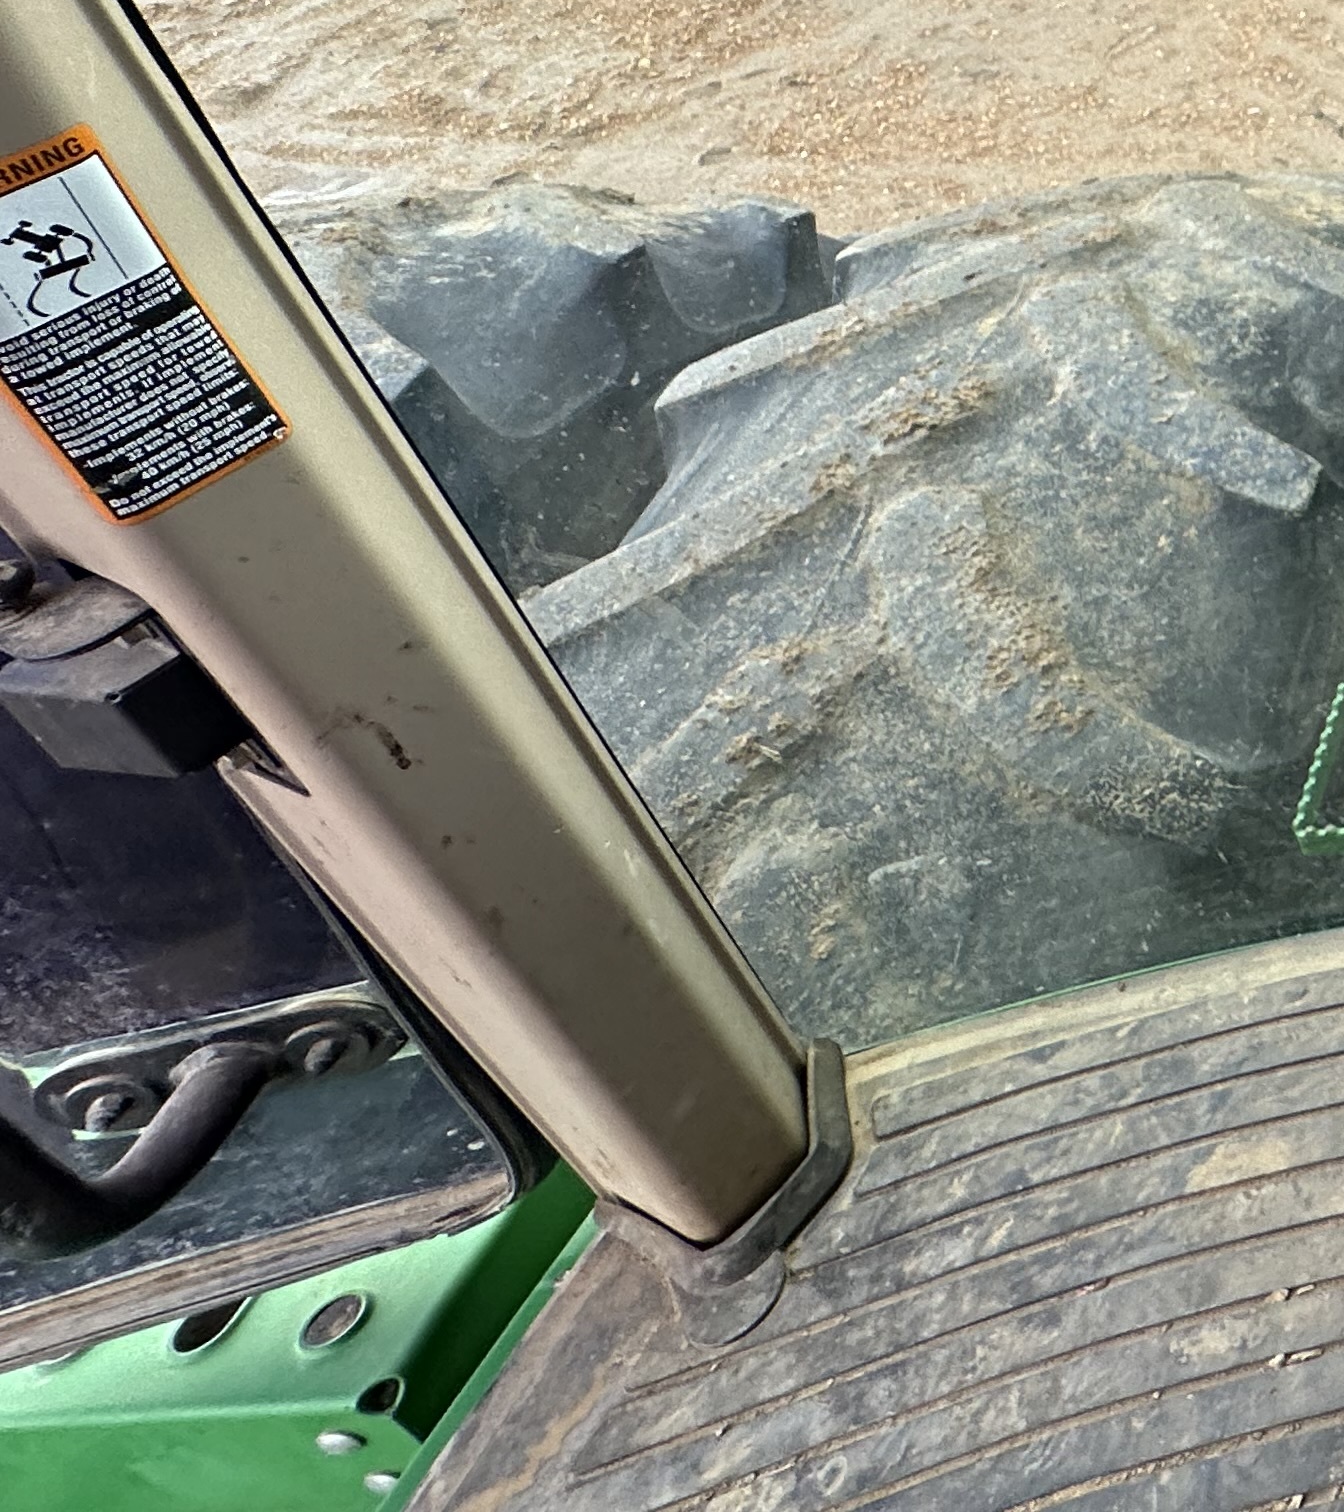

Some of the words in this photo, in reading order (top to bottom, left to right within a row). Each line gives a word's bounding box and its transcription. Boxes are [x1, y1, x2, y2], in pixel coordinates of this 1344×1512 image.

[31, 313, 82, 341] serious
[82, 293, 120, 316] injury
[123, 286, 136, 296] or
[139, 267, 171, 288] death
[48, 322, 108, 356] transport
[108, 315, 122, 326] or
[123, 292, 171, 319] braking
[170, 283, 182, 295] of
[57, 320, 91, 339] from
[91, 306, 120, 323] loss
[121, 297, 135, 308] of
[136, 274, 177, 301] control
[16, 383, 48, 397] This
[46, 365, 85, 387] tractor
[84, 359, 98, 369] is
[97, 337, 142, 363] capable
[141, 329, 154, 341] of
[20, 356, 64, 379] towed
[63, 322, 138, 360] implement.
[26, 395, 43, 406] at
[43, 366, 107, 400] transport
[107, 343, 154, 370] speeds
[154, 328, 182, 345] that
[182, 314, 205, 332] may
[33, 391, 81, 415] exceed
[80, 381, 102, 396] the
[102, 351, 161, 385] maximum
[160, 323, 212, 355] allowable
[39, 388, 111, 424] transport
[113, 365, 156, 391] speed
[157, 354, 178, 368] for
[180, 329, 218, 356] towed
[141, 377, 154, 388] If
[155, 339, 224, 381] implement
[54, 399, 138, 441] manufacturer
[139, 383, 169, 402] does
[168, 371, 190, 386] not
[192, 348, 233, 374] specify
[61, 421, 120, 449] maximum
[117, 396, 166, 425] transport
[67, 439, 108, 458] these
[107, 408, 165, 442] transport
[165, 388, 203, 412] speed
[201, 368, 239, 392] limits:
[163, 402, 209, 430] without
[208, 379, 250, 405] brakes:
[186, 426, 213, 443] with
[213, 402, 256, 429] brakes:
[108, 497, 129, 508] Do
[130, 485, 152, 500] not
[152, 462, 194, 489] exceed
[192, 452, 213, 466] the
[213, 413, 277, 455] implement's
[125, 448, 145, 461] 32
[144, 432, 177, 452] km/h
[177, 418, 198, 435] (20
[199, 401, 231, 422] mph)
[142, 467, 159, 479] 40
[158, 450, 190, 470] km/h
[190, 437, 212, 453] (25
[212, 420, 243, 441] mph)
[116, 483, 180, 516] maximum
[179, 451, 234, 485] transport
